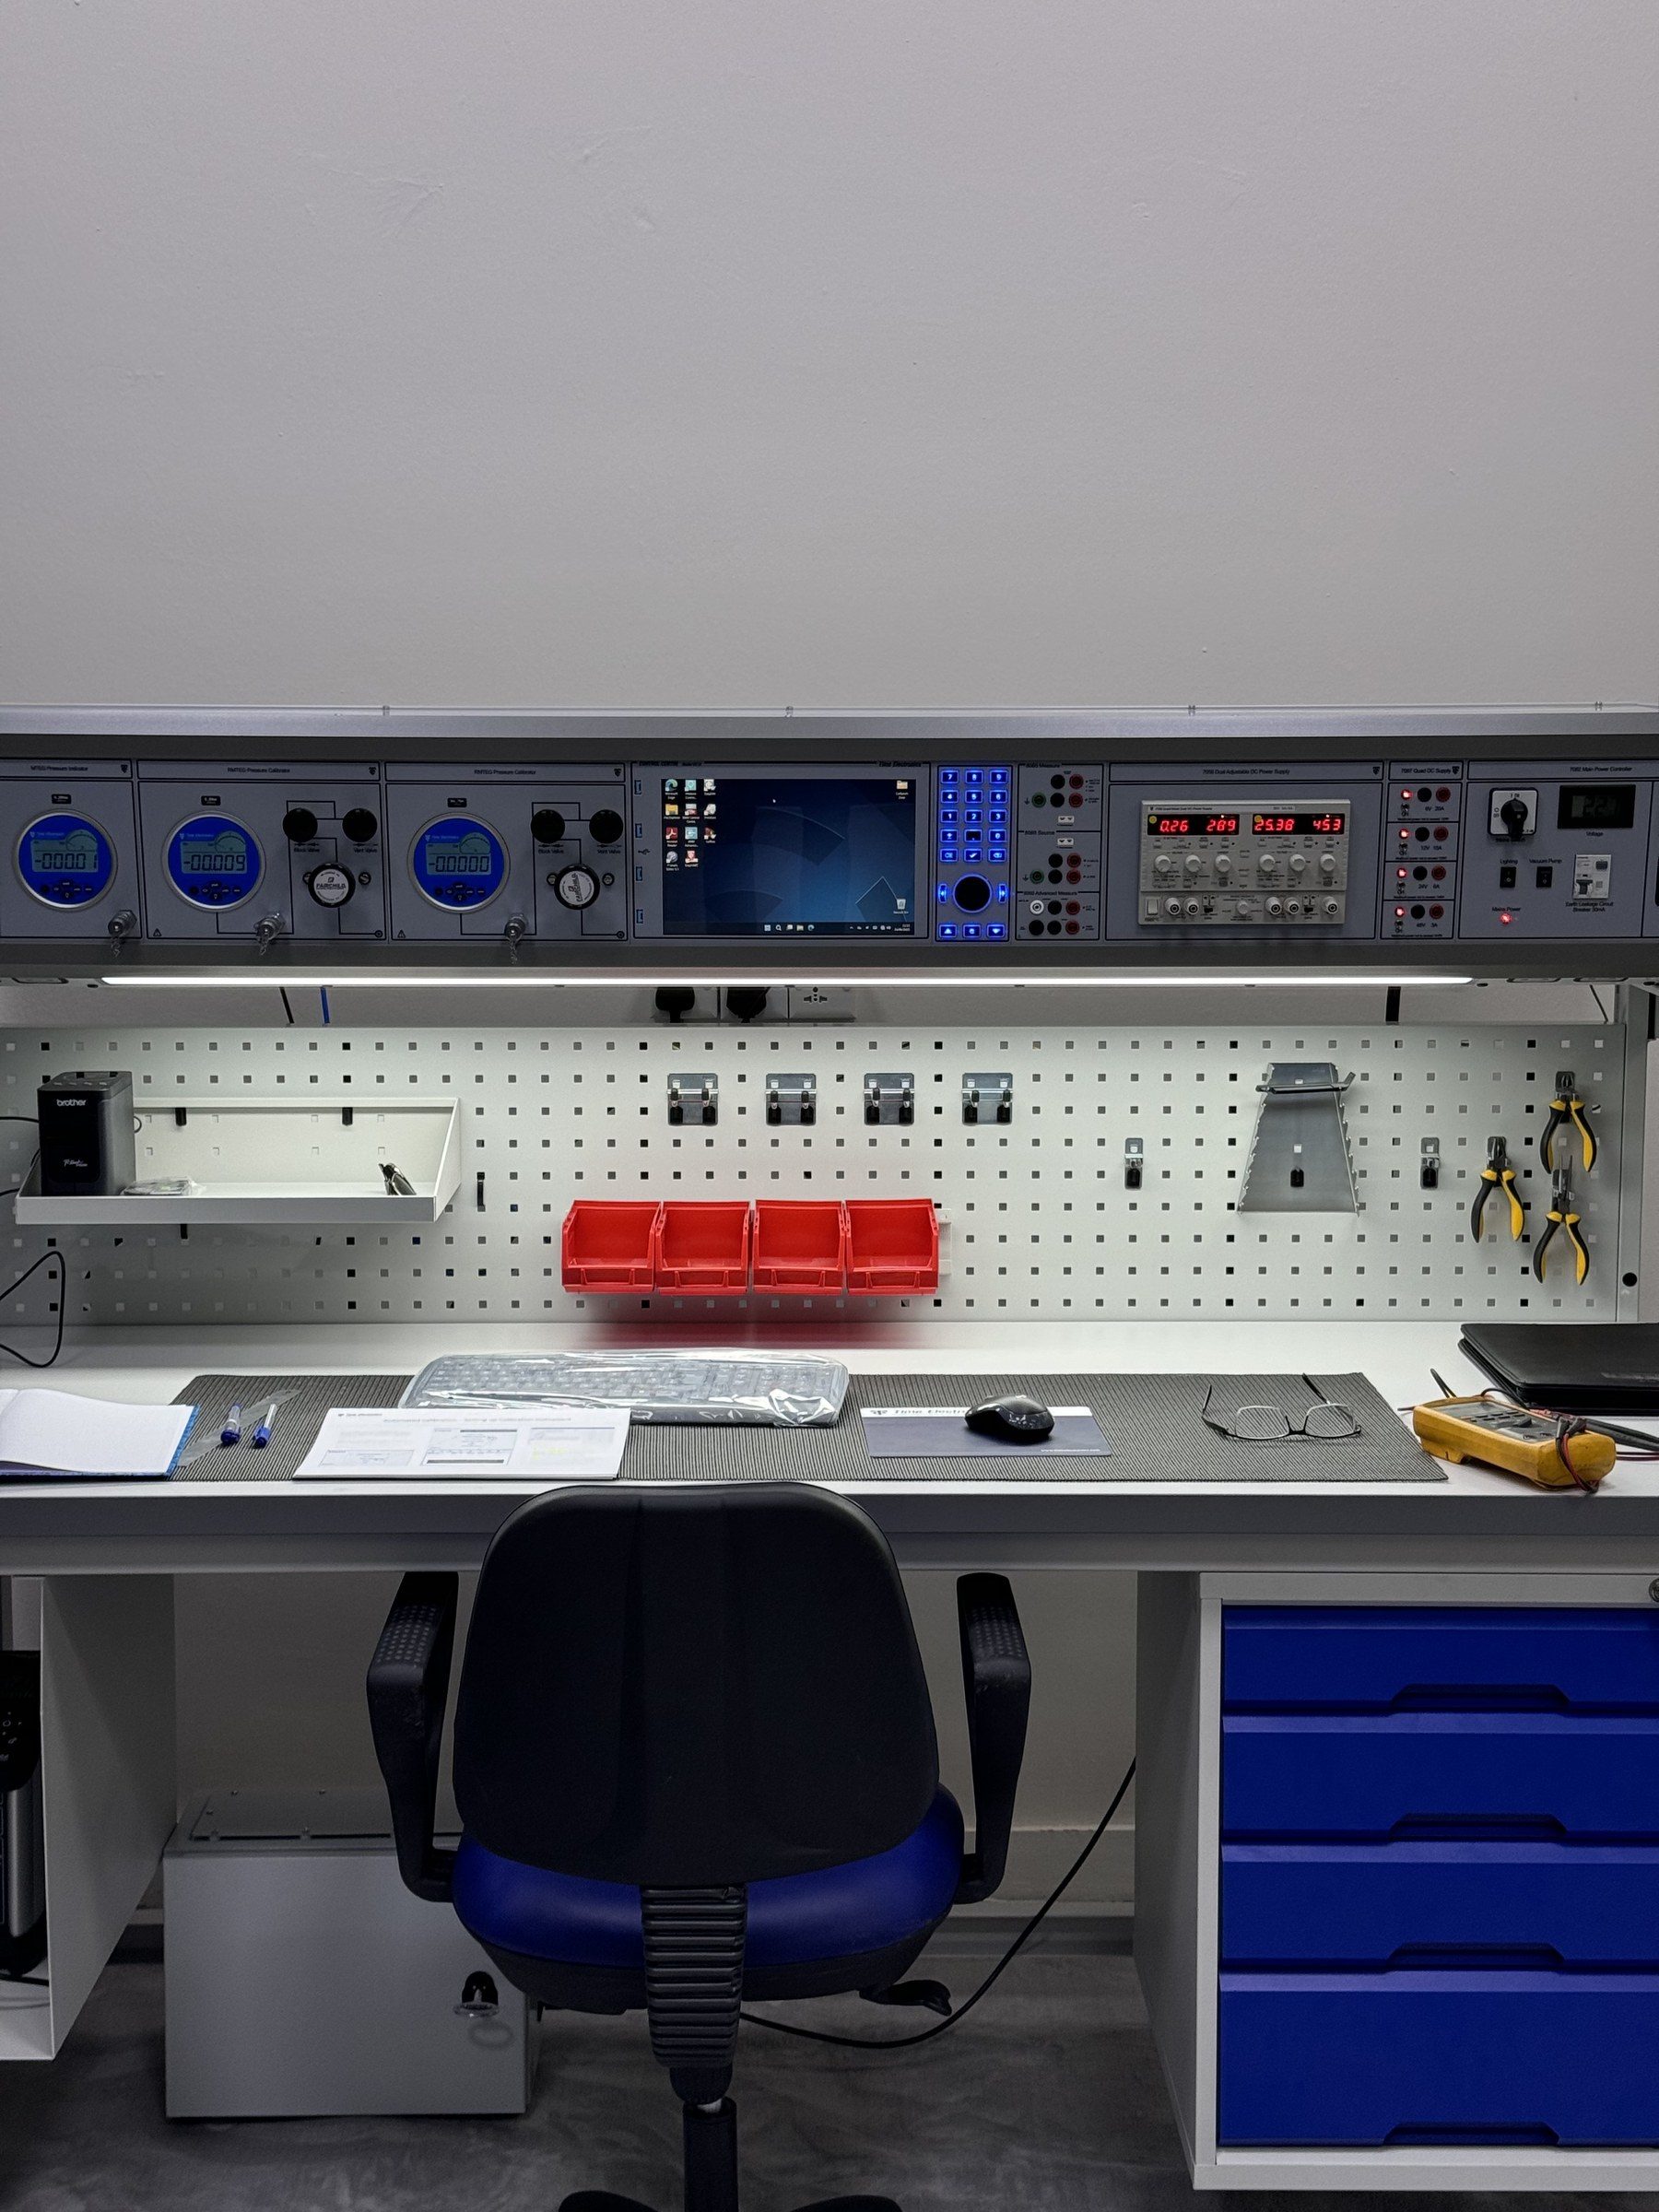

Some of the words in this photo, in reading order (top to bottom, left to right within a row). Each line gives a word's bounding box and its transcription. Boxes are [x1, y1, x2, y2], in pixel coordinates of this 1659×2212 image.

[1159, 819, 1188, 832] 0.26
[1206, 819, 1236, 831] 289
[1254, 818, 1295, 831] 25.38
[1312, 818, 1341, 831] 453
[56, 1099, 87, 1107] brother
